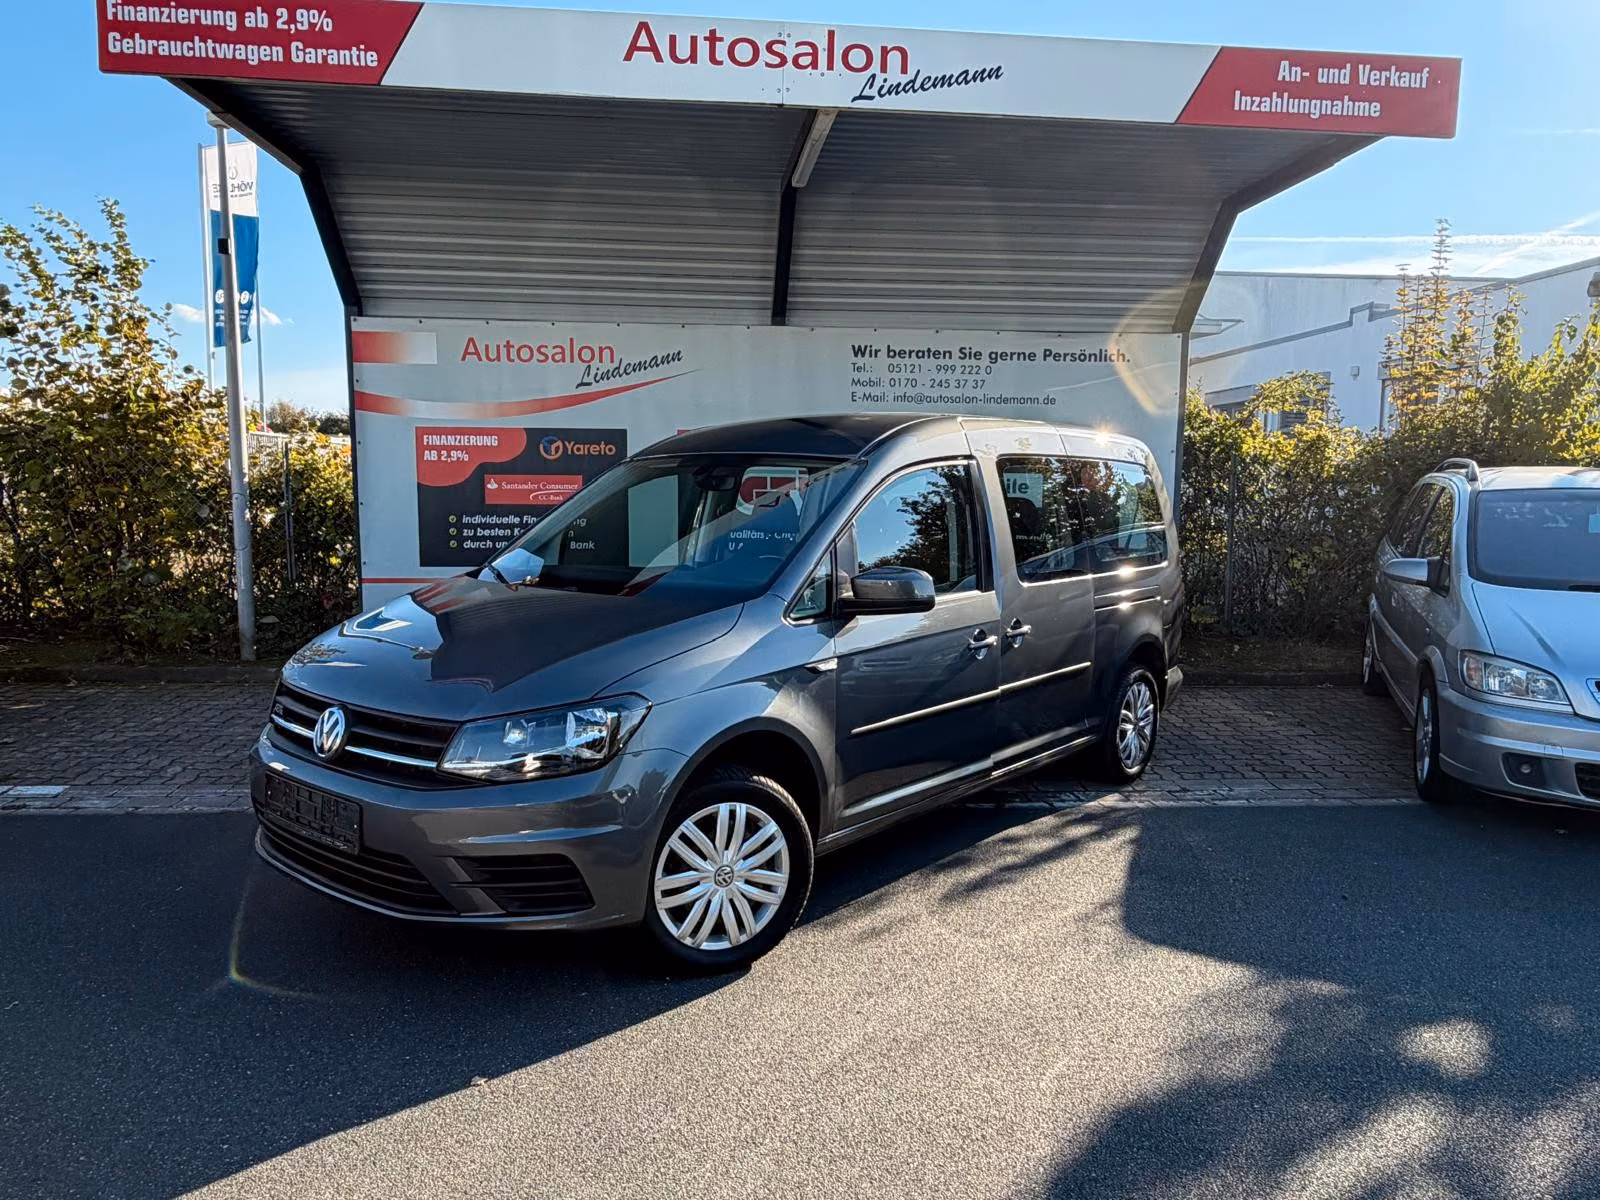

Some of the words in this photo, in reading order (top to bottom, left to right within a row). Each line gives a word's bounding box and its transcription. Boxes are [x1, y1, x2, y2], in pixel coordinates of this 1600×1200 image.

[106, 0, 237, 31] Finanzierung
[244, 10, 269, 29] ab
[276, 8, 333, 34] 2,9%
[107, 32, 284, 66] Gebrauchtwagen
[290, 41, 378, 67] Garantie
[623, 21, 910, 75] Autosalon
[1277, 60, 1310, 83] An-
[1317, 63, 1351, 85] und
[1358, 64, 1429, 89] Verkauf
[850, 65, 1004, 103] Lindemann
[1233, 90, 1381, 119] Inzahlungnahme
[460, 337, 616, 364] Autosalon
[851, 345, 881, 360] Wir
[886, 345, 953, 361] beraten
[958, 346, 983, 361] Sie
[988, 350, 1037, 364] gerne
[1042, 348, 1131, 364] Persönlich.
[575, 350, 684, 389] Lindemann
[851, 363, 873, 374] Tel.:
[888, 363, 922, 375] 05121
[935, 364, 956, 376] 999
[960, 365, 982, 376] 222
[985, 365, 993, 376] 0
[851, 377, 885, 389] Mobil:
[889, 377, 918, 389] 0170
[930, 378, 951, 390] 245
[954, 379, 969, 390] 37
[971, 379, 986, 390] 37
[851, 392, 889, 403] E-Mail:
[893, 392, 1057, 406] info@autosalon-lindemann.de
[423, 435, 498, 447] FINANZIERUNG
[565, 441, 616, 456] Yareto
[423, 450, 438, 461] AB
[441, 450, 469, 463] 2,9%
[501, 481, 538, 490] Santander
[540, 481, 578, 490] Consumer
[462, 515, 521, 524] individuelle
[477, 528, 511, 537] besten
[463, 540, 493, 549] durch
[570, 541, 595, 550] Bank
